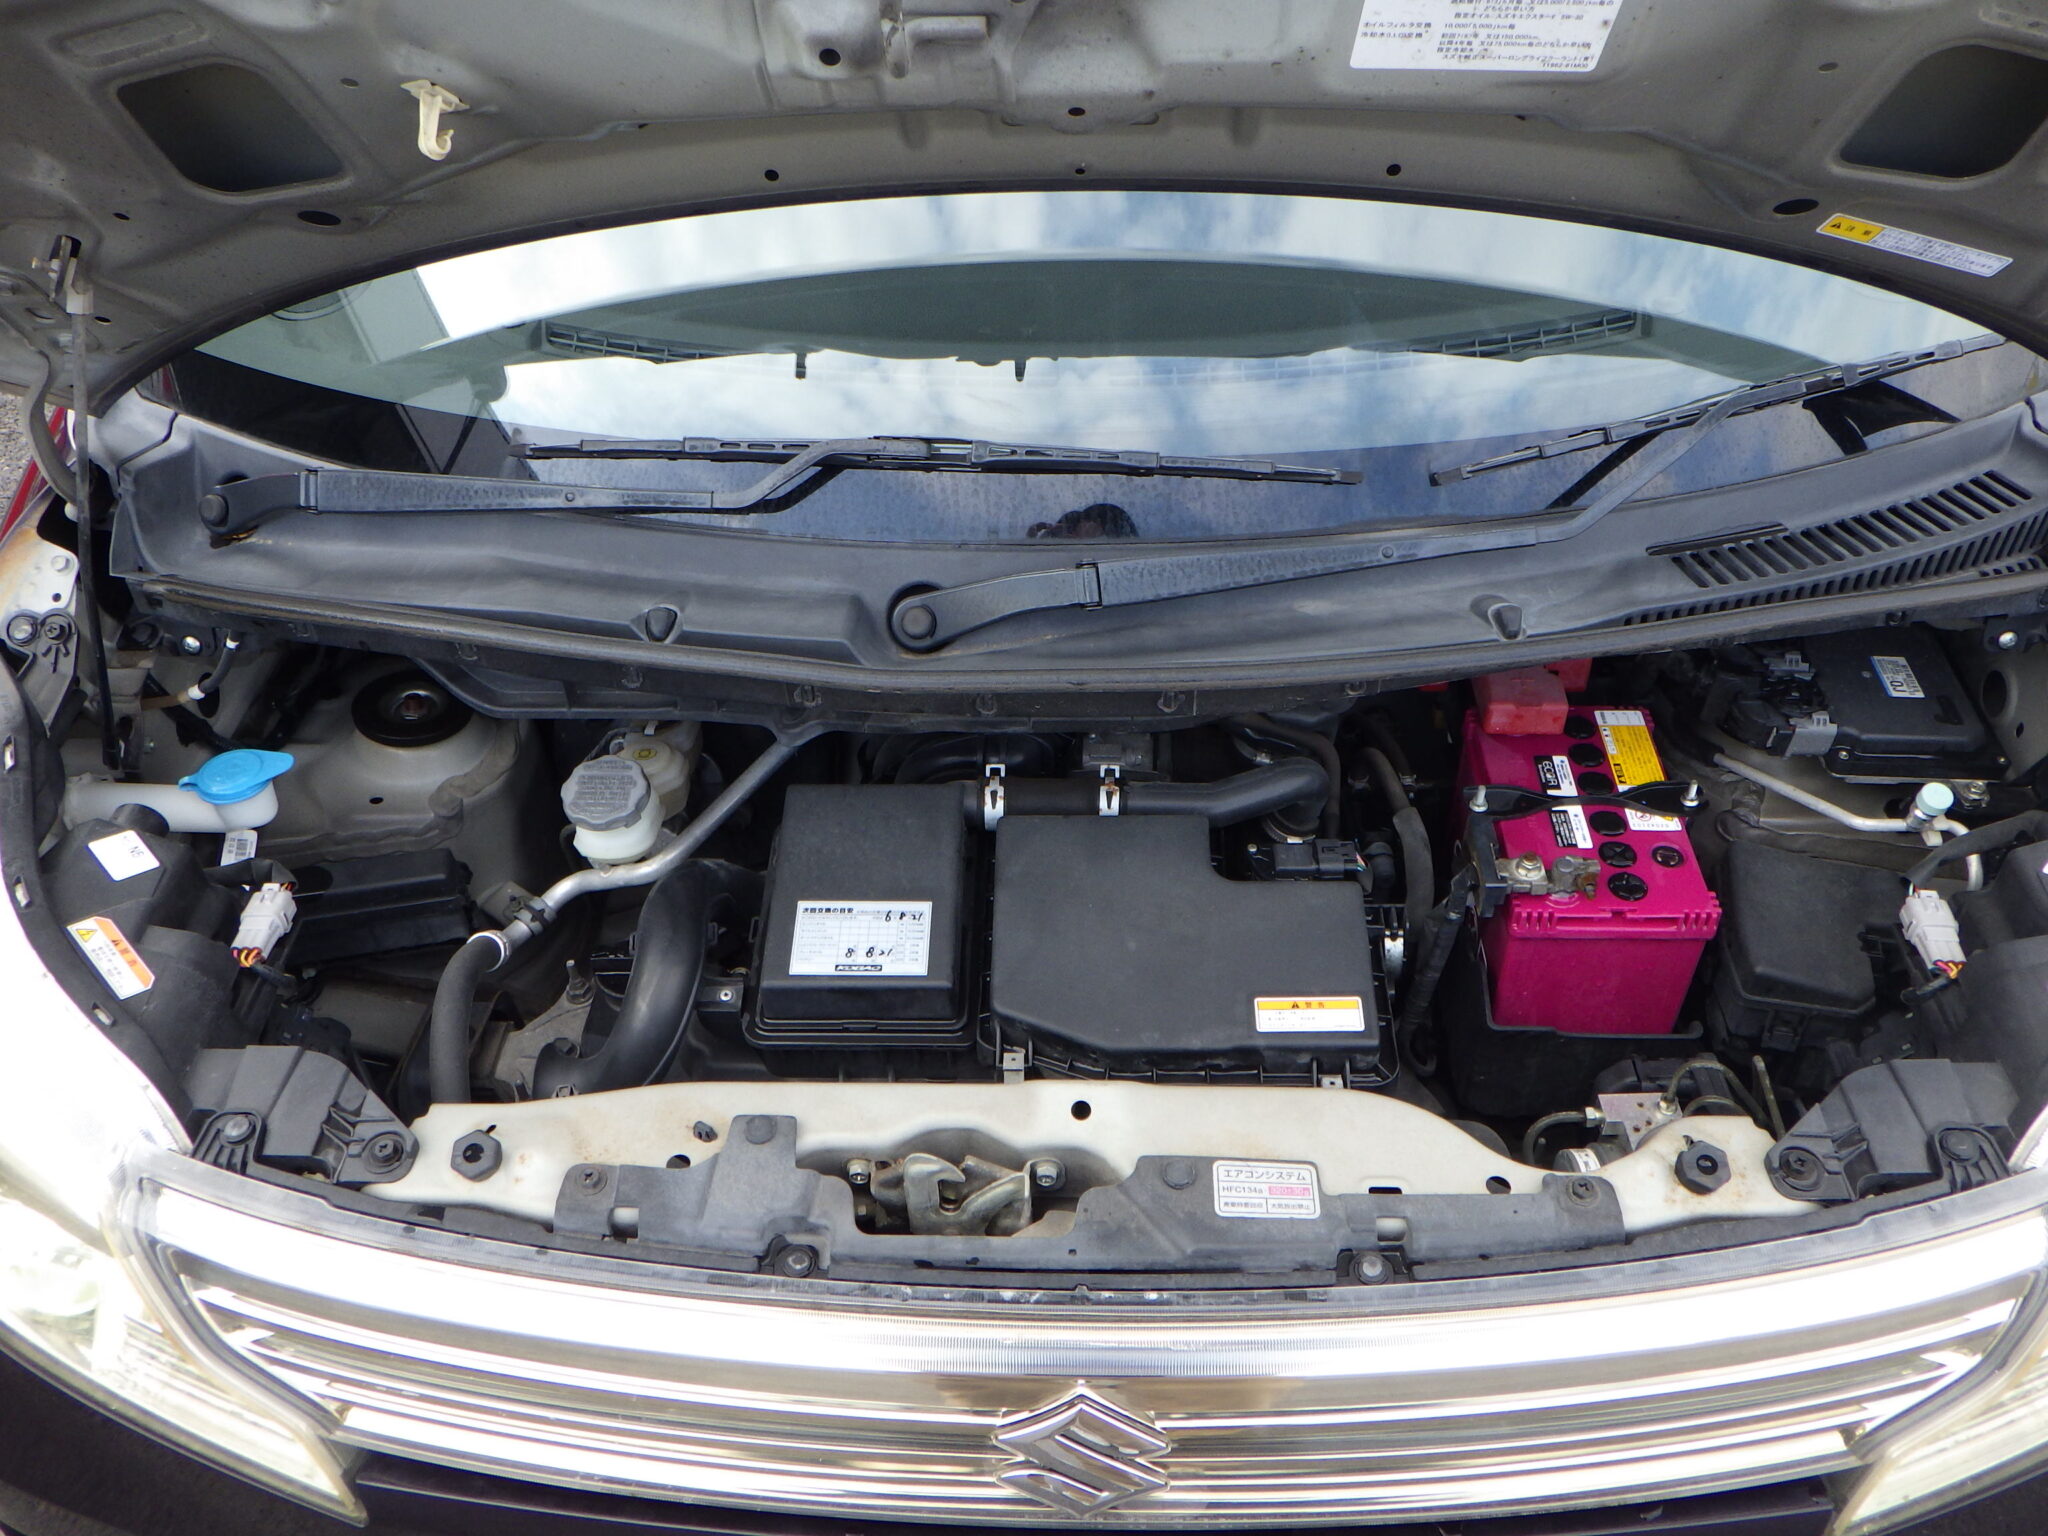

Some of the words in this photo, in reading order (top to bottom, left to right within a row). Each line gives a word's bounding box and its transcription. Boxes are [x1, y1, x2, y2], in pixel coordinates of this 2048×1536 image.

[1223, 1169, 1306, 1181] エアコンシステム
